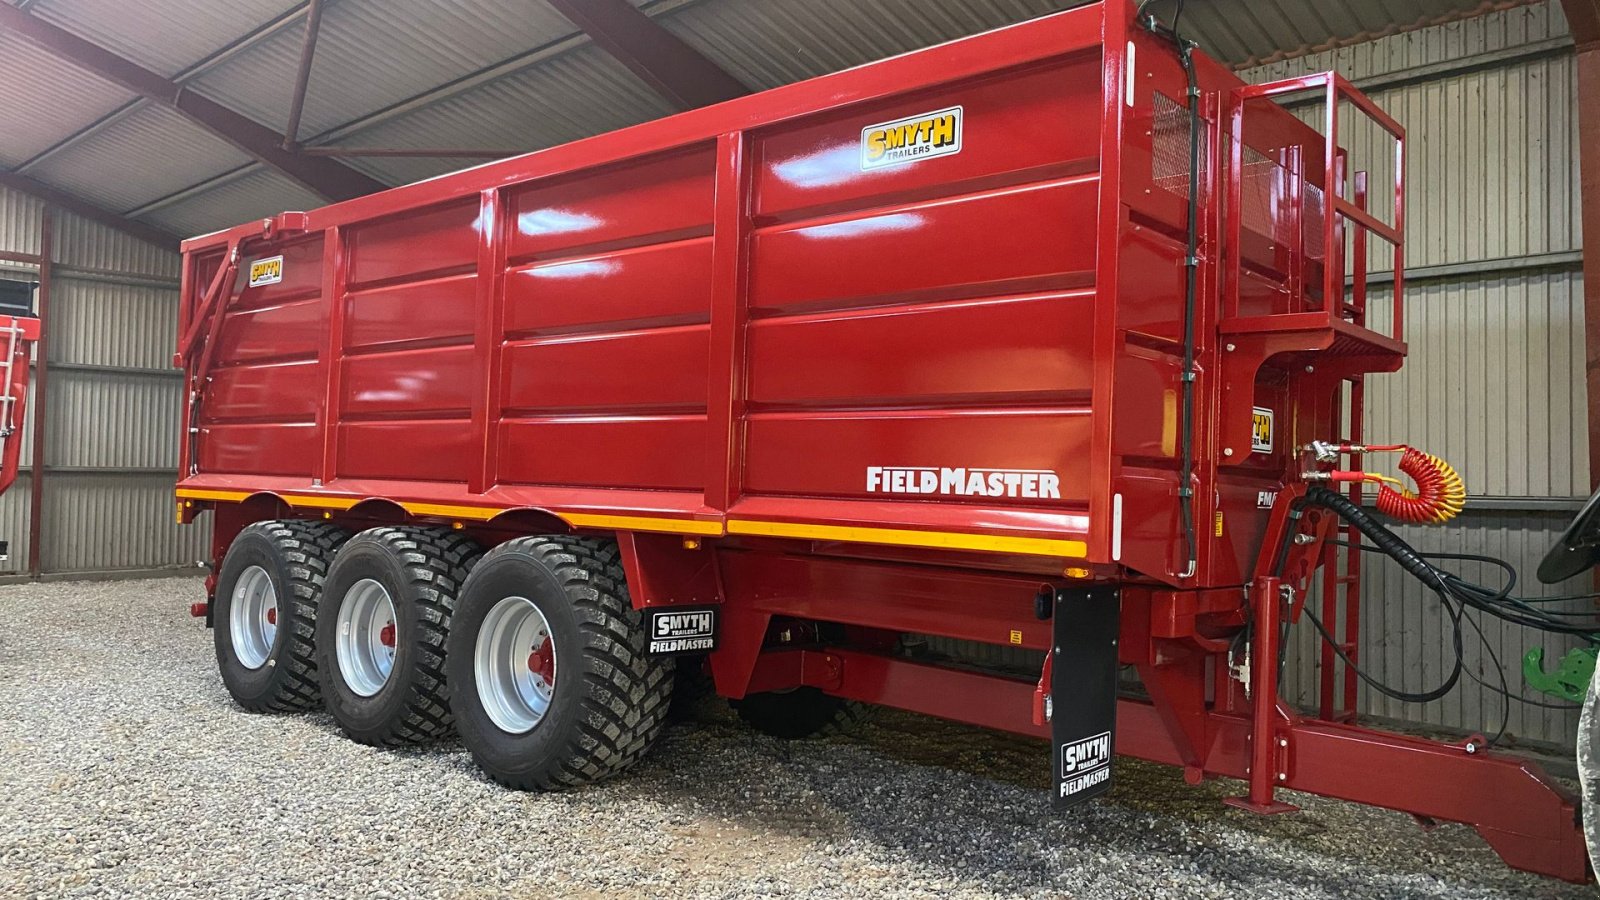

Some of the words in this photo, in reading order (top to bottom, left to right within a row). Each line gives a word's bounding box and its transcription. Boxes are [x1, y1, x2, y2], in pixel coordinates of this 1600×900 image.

[867, 115, 955, 162] SMYTH
[887, 145, 930, 160] TRAILERS
[252, 261, 280, 282] SMYTH
[658, 614, 710, 635] SMYTH
[671, 628, 698, 636] TRAILERS
[1065, 736, 1108, 772] SMYTH
[1077, 757, 1099, 771] TRAILERS
